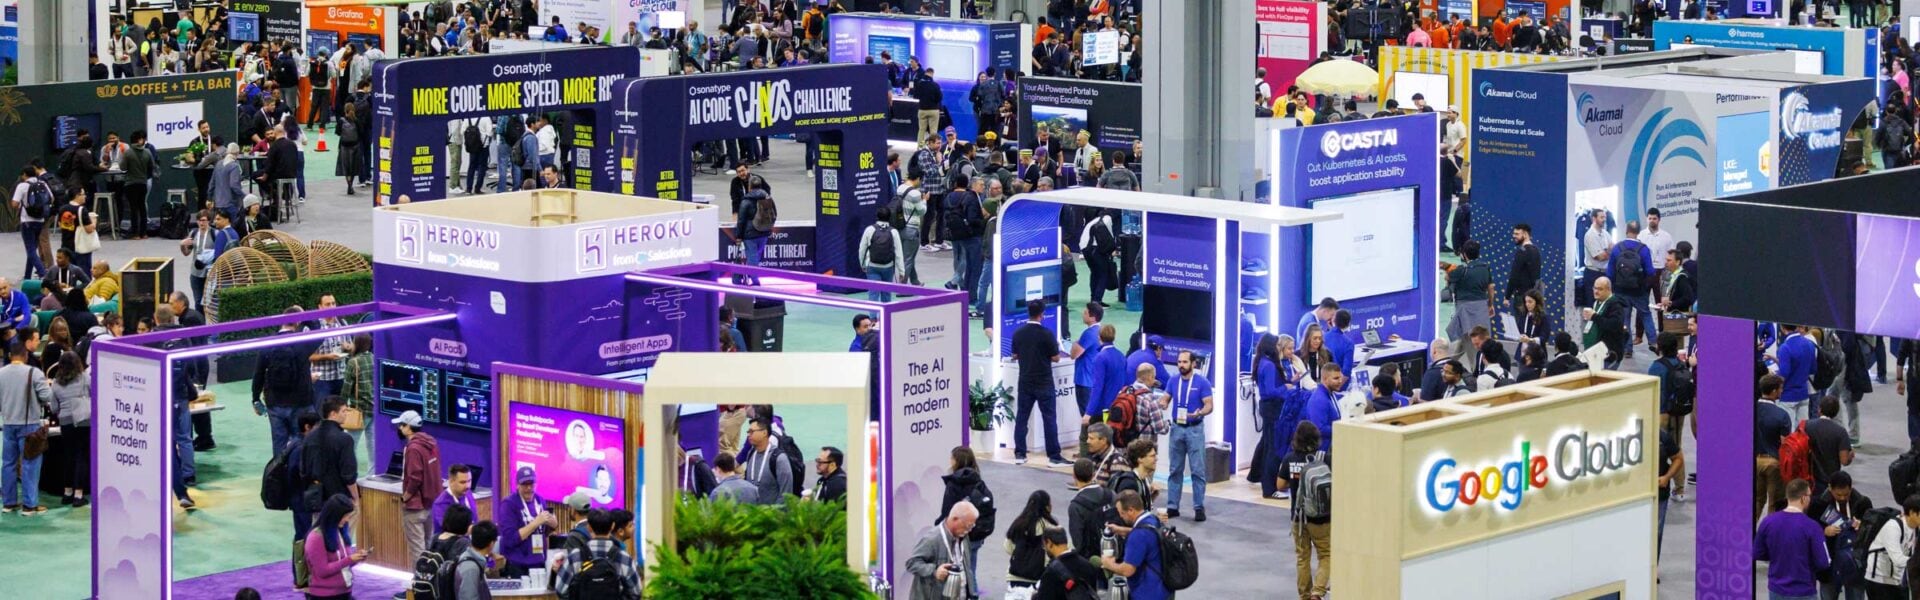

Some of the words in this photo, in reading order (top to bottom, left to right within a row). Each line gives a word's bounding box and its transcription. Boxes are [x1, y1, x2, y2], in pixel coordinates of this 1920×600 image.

[337, 9, 363, 19] Grafana
[1736, 29, 1765, 38] harness
[503, 62, 552, 76] sonatype
[121, 82, 168, 96] COFFEE
[182, 79, 204, 92] TEA
[207, 77, 232, 90] BAR
[696, 84, 732, 97] sonatype
[1023, 83, 1037, 91] Your
[1037, 84, 1045, 92] AI
[1045, 84, 1072, 95] Powered
[1073, 86, 1091, 96] Portal
[1092, 88, 1099, 96] to
[1486, 88, 1514, 98] Akamai
[1514, 90, 1537, 100] Cloud
[412, 86, 449, 116] MORE
[450, 84, 486, 113] CODE.
[487, 81, 522, 111] MORE
[523, 79, 562, 108] SPEED.
[563, 76, 597, 105] MORE
[689, 98, 701, 125] AI
[702, 96, 733, 124] CODE
[734, 79, 793, 129] CHAOS
[794, 87, 853, 116] CHALLENGE
[1023, 92, 1059, 105] Engineering
[1060, 95, 1093, 106] Excellence
[1479, 116, 1515, 126] Kubernetes
[1585, 104, 1624, 123] Akamai
[1794, 106, 1843, 133] Akamai
[156, 116, 193, 135] ngrok
[1479, 125, 1520, 135] Performance
[1527, 128, 1545, 137] Scale
[1599, 122, 1623, 137] Cloud
[1341, 130, 1383, 151] CAST
[1382, 128, 1398, 146] AI
[1808, 131, 1841, 150] Cloud
[1307, 163, 1321, 173] Cut
[1322, 157, 1367, 171] Kubernetes
[1367, 156, 1374, 166] &
[1375, 154, 1384, 164] AI
[1384, 153, 1408, 163] costs,
[1309, 176, 1332, 187] boost
[1332, 170, 1374, 185] application
[1374, 166, 1405, 178] stability
[427, 225, 498, 250] HEROKU
[614, 219, 692, 245] HEROKU
[613, 254, 635, 266] from
[647, 247, 692, 262] Salesforce
[778, 244, 807, 258] THREAT
[1020, 247, 1040, 257] CAST
[1040, 246, 1048, 255] AI
[428, 251, 447, 264] from
[459, 255, 500, 272] Salesforce
[779, 260, 794, 269] your
[795, 259, 813, 267] stack
[1153, 257, 1166, 266] Cut
[1166, 259, 1203, 270] Kubernetes
[1203, 263, 1209, 271] &
[1151, 275, 1185, 285] application
[1185, 280, 1211, 290] stability
[1166, 269, 1185, 277] costs,
[1185, 270, 1204, 279] boost
[919, 324, 945, 335] HEROKU
[1366, 317, 1385, 330] FICO
[434, 342, 442, 351] AI
[443, 344, 463, 354] PaaS
[603, 339, 645, 355] Intelligent
[647, 338, 668, 350] Apps
[908, 362, 929, 377] The
[931, 357, 944, 374] AI
[123, 375, 146, 385] HEROKU
[903, 378, 932, 397] PaaS
[935, 377, 951, 391] for
[114, 398, 133, 415] The
[133, 402, 144, 416] AI
[903, 397, 950, 416] modern
[110, 414, 134, 432] PaaS
[135, 419, 148, 433] for
[910, 417, 943, 436] apps.
[110, 433, 148, 450] modern
[115, 450, 142, 467] apps.
[1426, 440, 1548, 512] Google
[1555, 419, 1643, 481] Cloud
